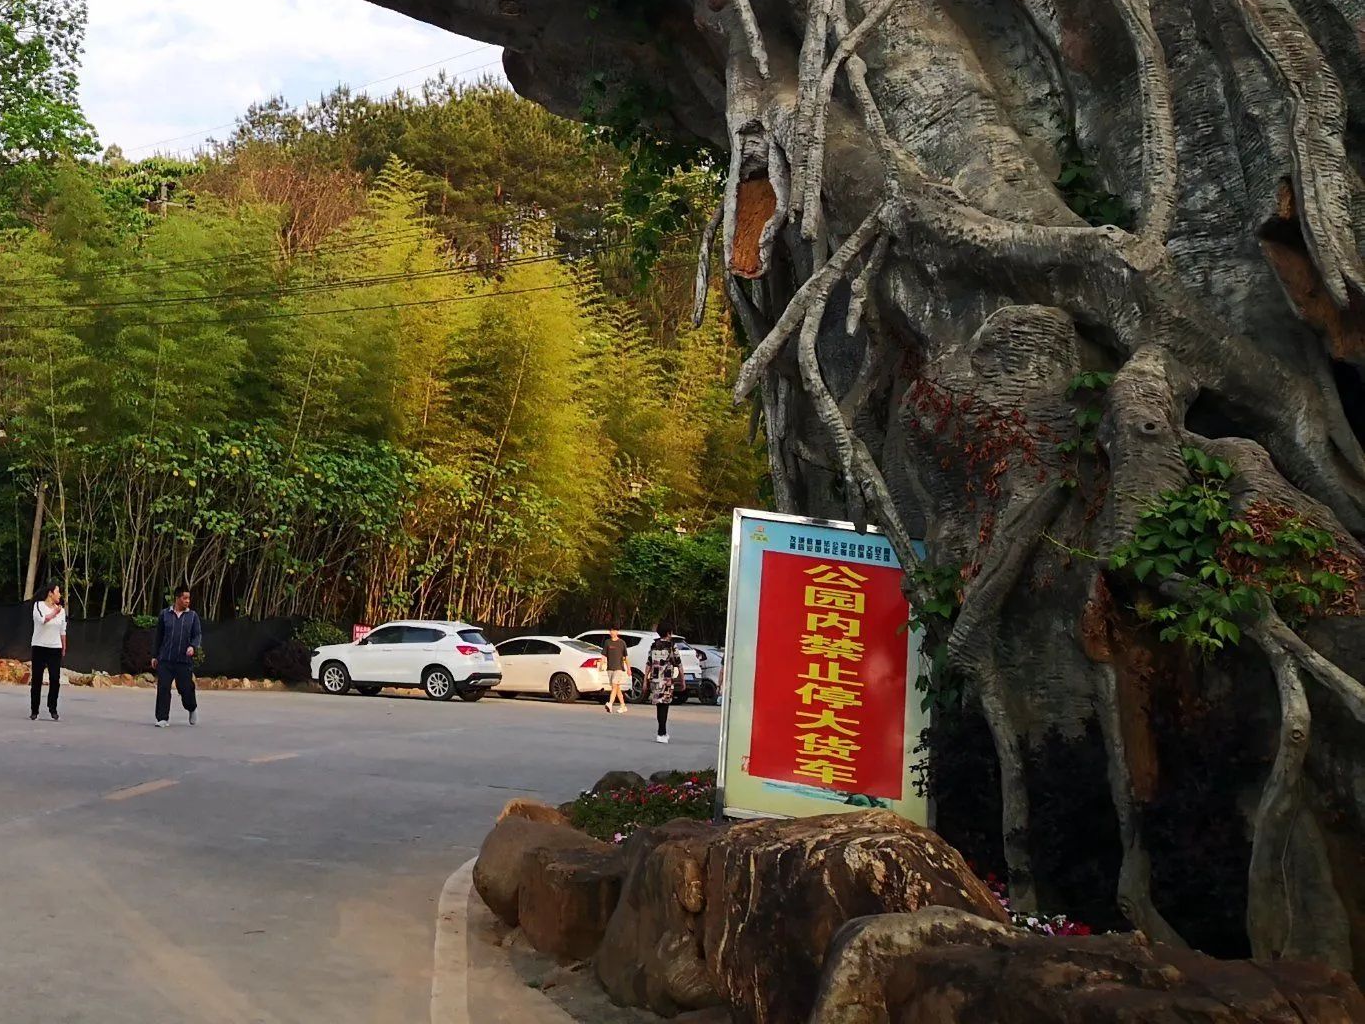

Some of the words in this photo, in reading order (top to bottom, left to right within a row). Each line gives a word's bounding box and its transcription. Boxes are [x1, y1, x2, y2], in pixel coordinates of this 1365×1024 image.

[793, 564, 869, 784] 公园内禁止停大货车
